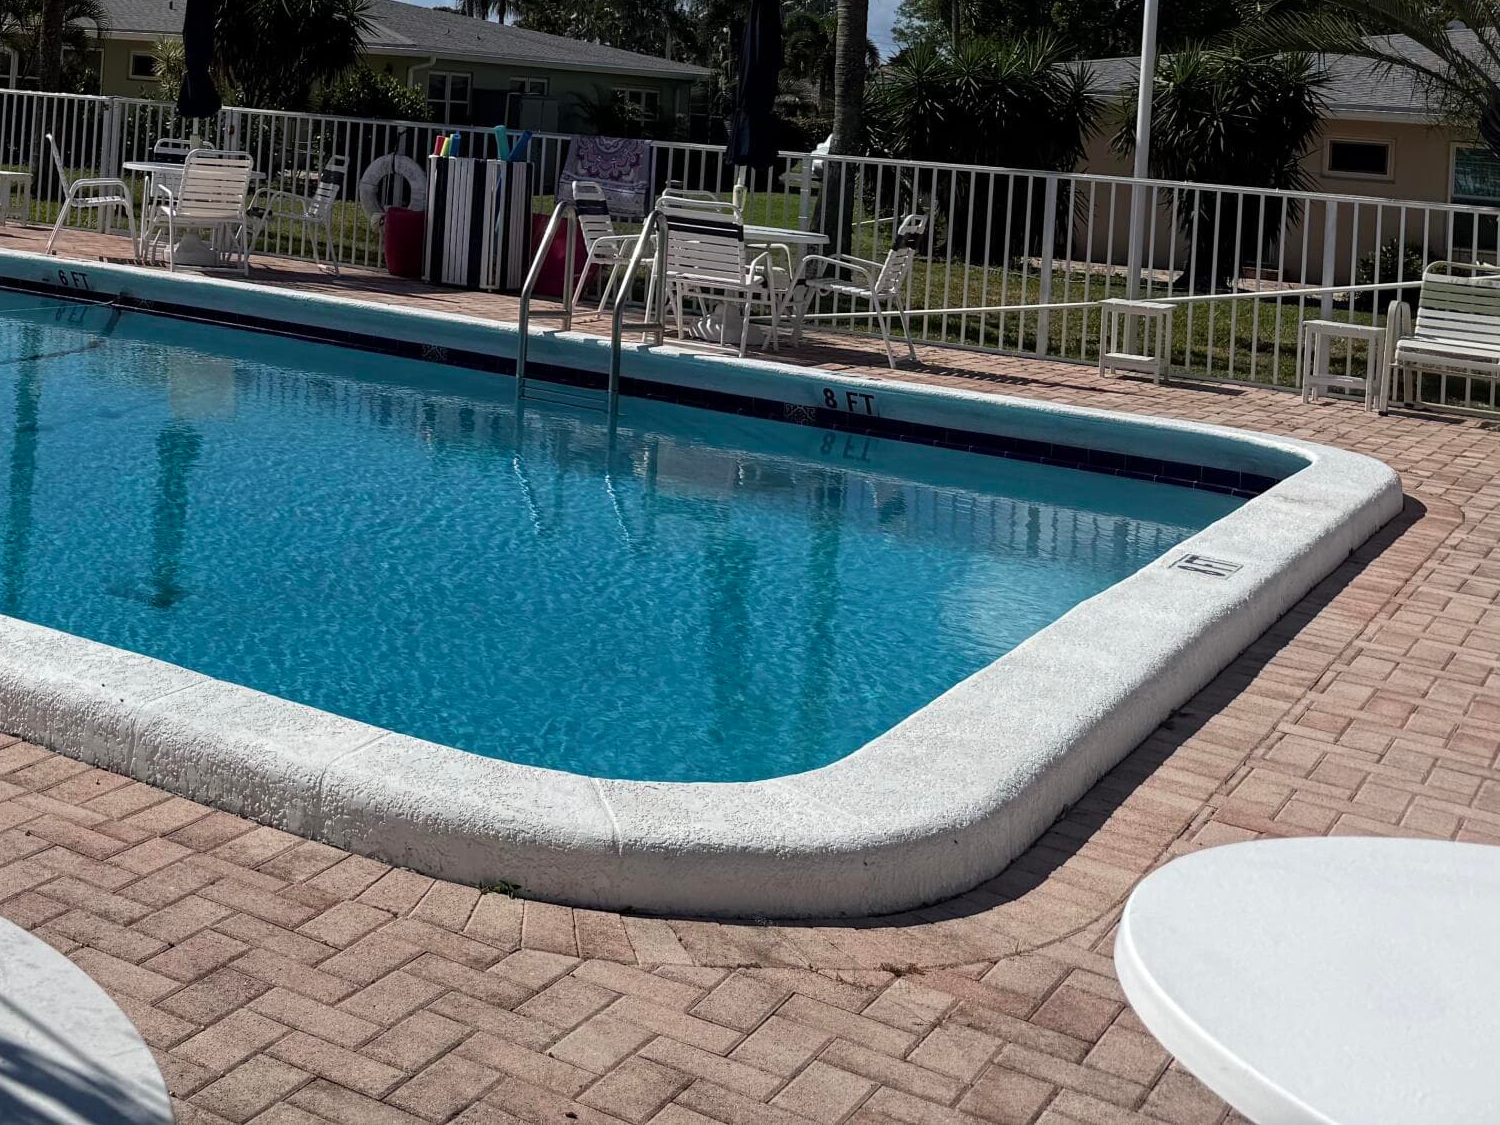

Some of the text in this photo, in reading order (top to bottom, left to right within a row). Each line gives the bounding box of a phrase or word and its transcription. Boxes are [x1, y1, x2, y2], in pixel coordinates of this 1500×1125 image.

[58, 269, 88, 290] 6 FT
[823, 388, 875, 415] 8 FT
